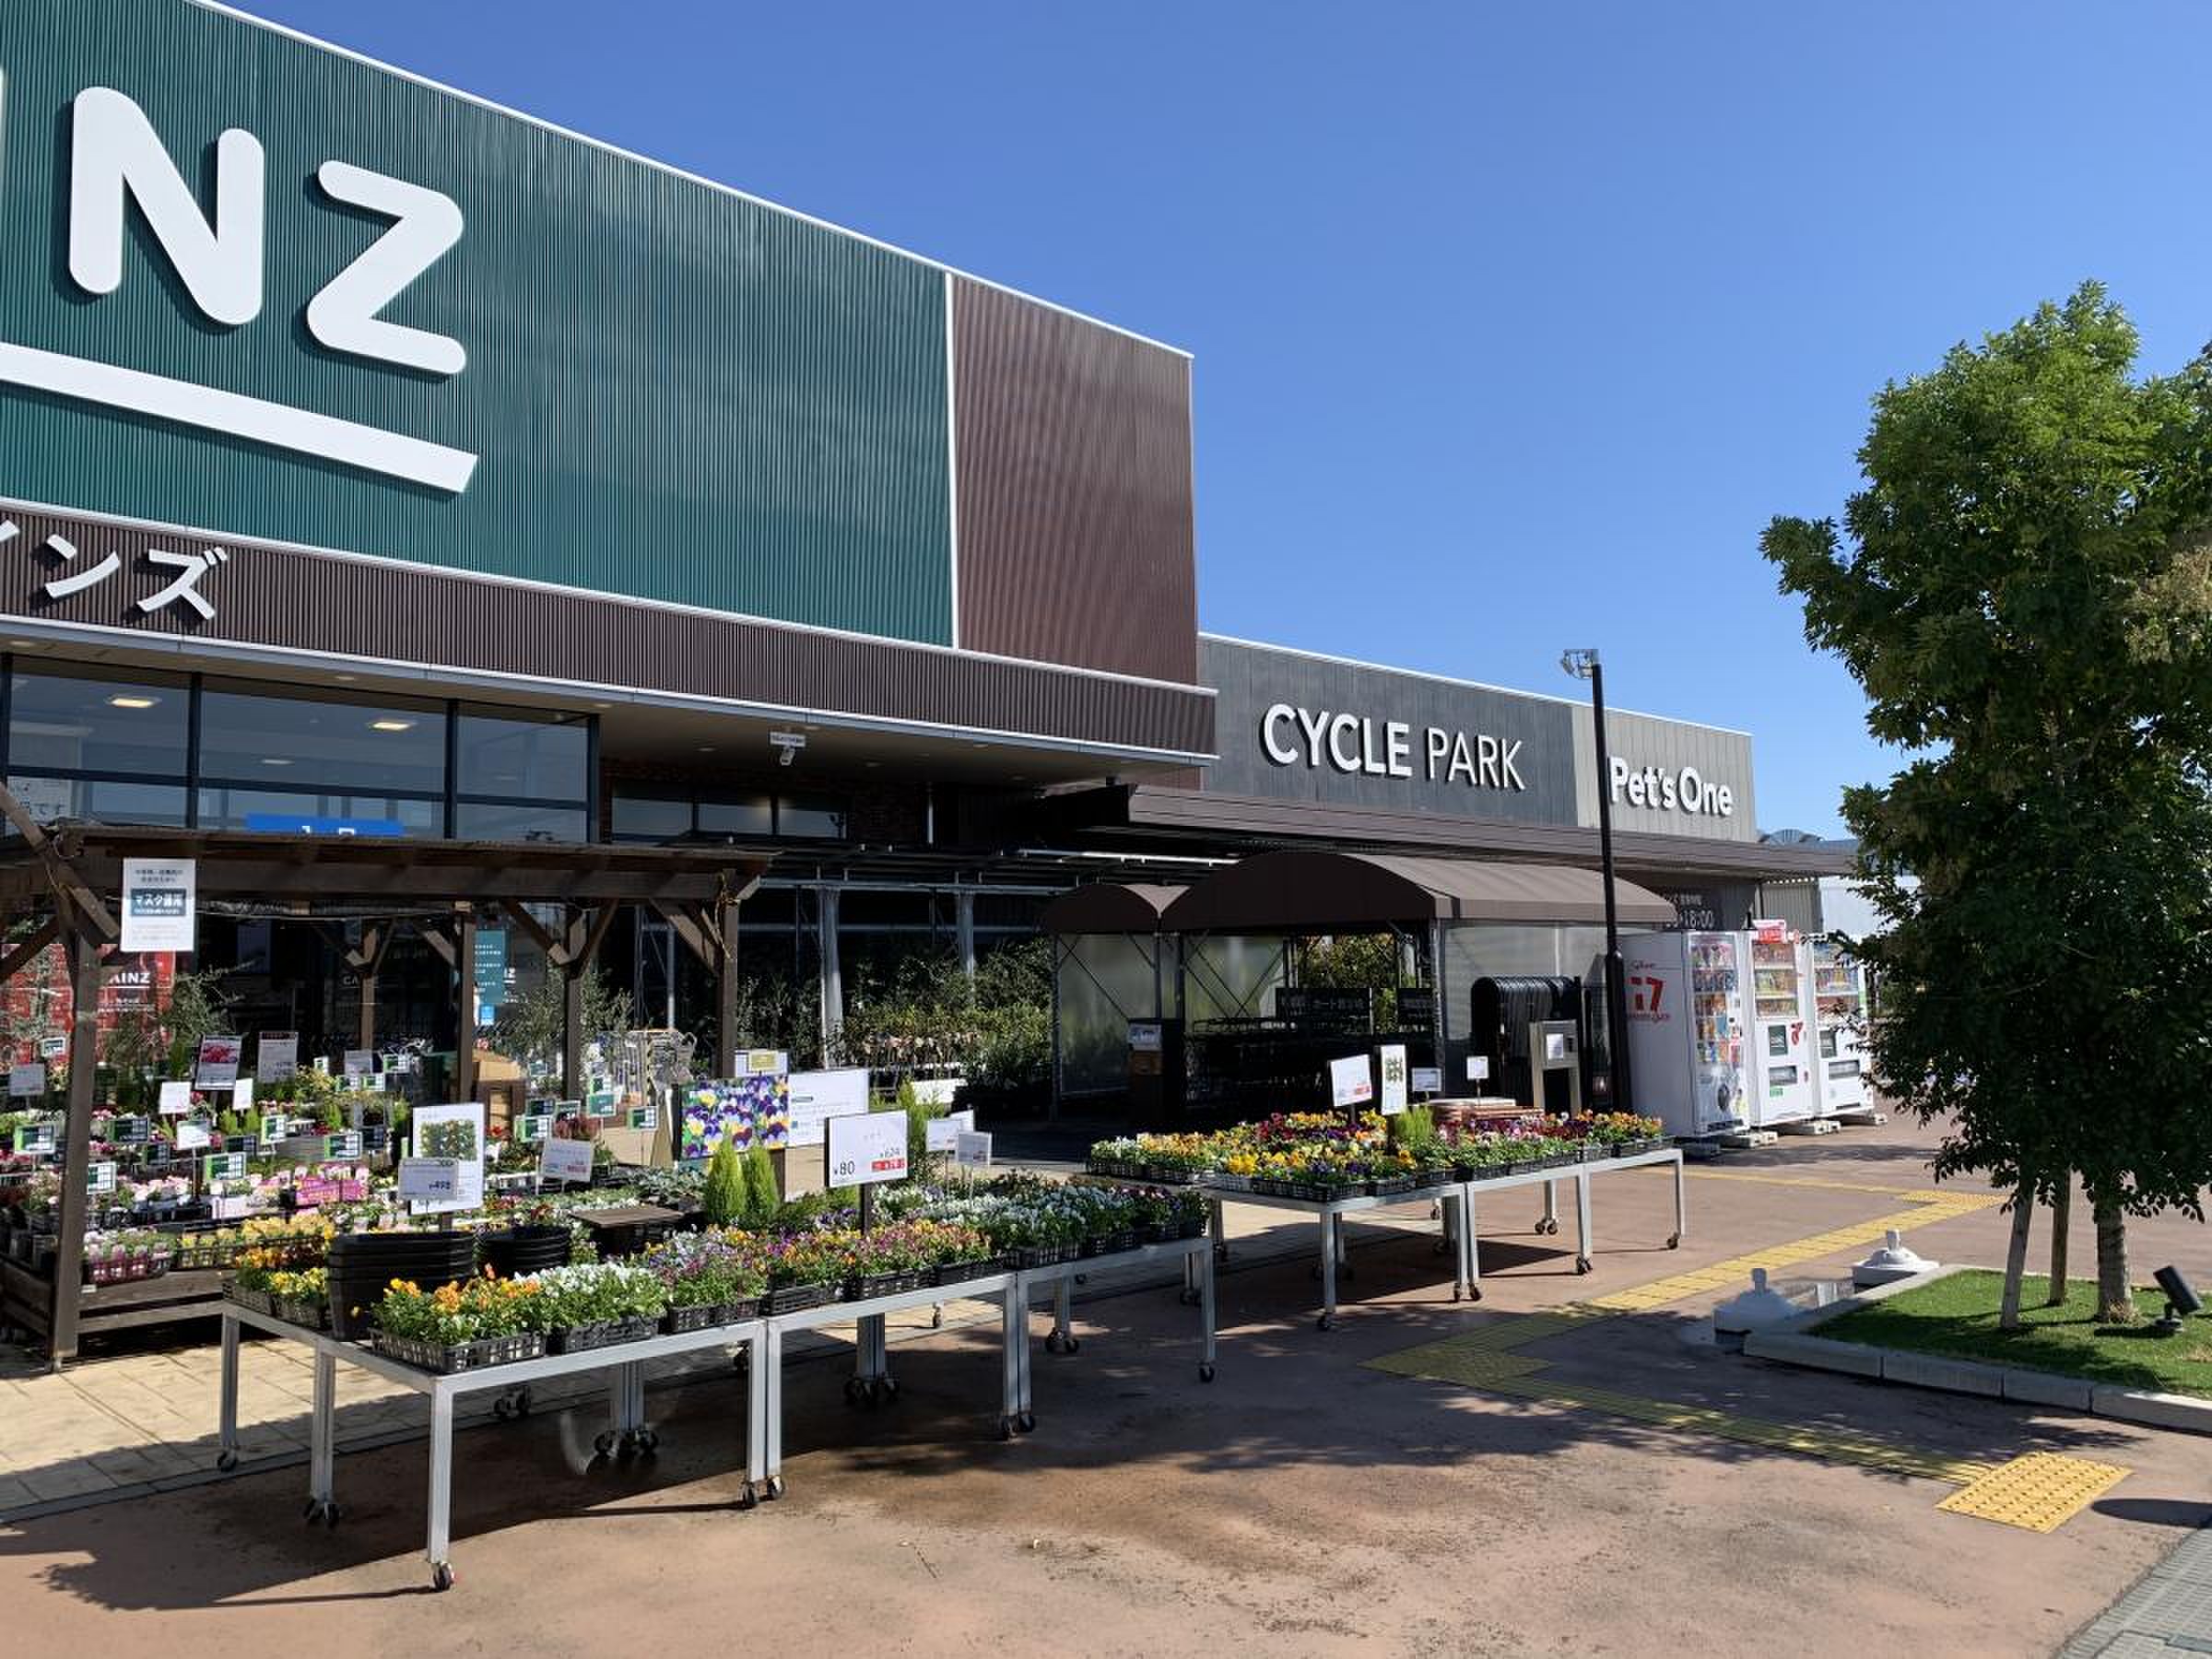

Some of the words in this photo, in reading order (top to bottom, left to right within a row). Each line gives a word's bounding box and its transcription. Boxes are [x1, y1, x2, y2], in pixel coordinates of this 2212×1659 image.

[0, 69, 466, 374] NZ
[1264, 703, 1412, 776] CYCLE
[1429, 726, 1525, 790] PARK
[1610, 756, 1677, 809] Pet's
[1680, 766, 1734, 816] One
[108, 972, 150, 984] AINZ
